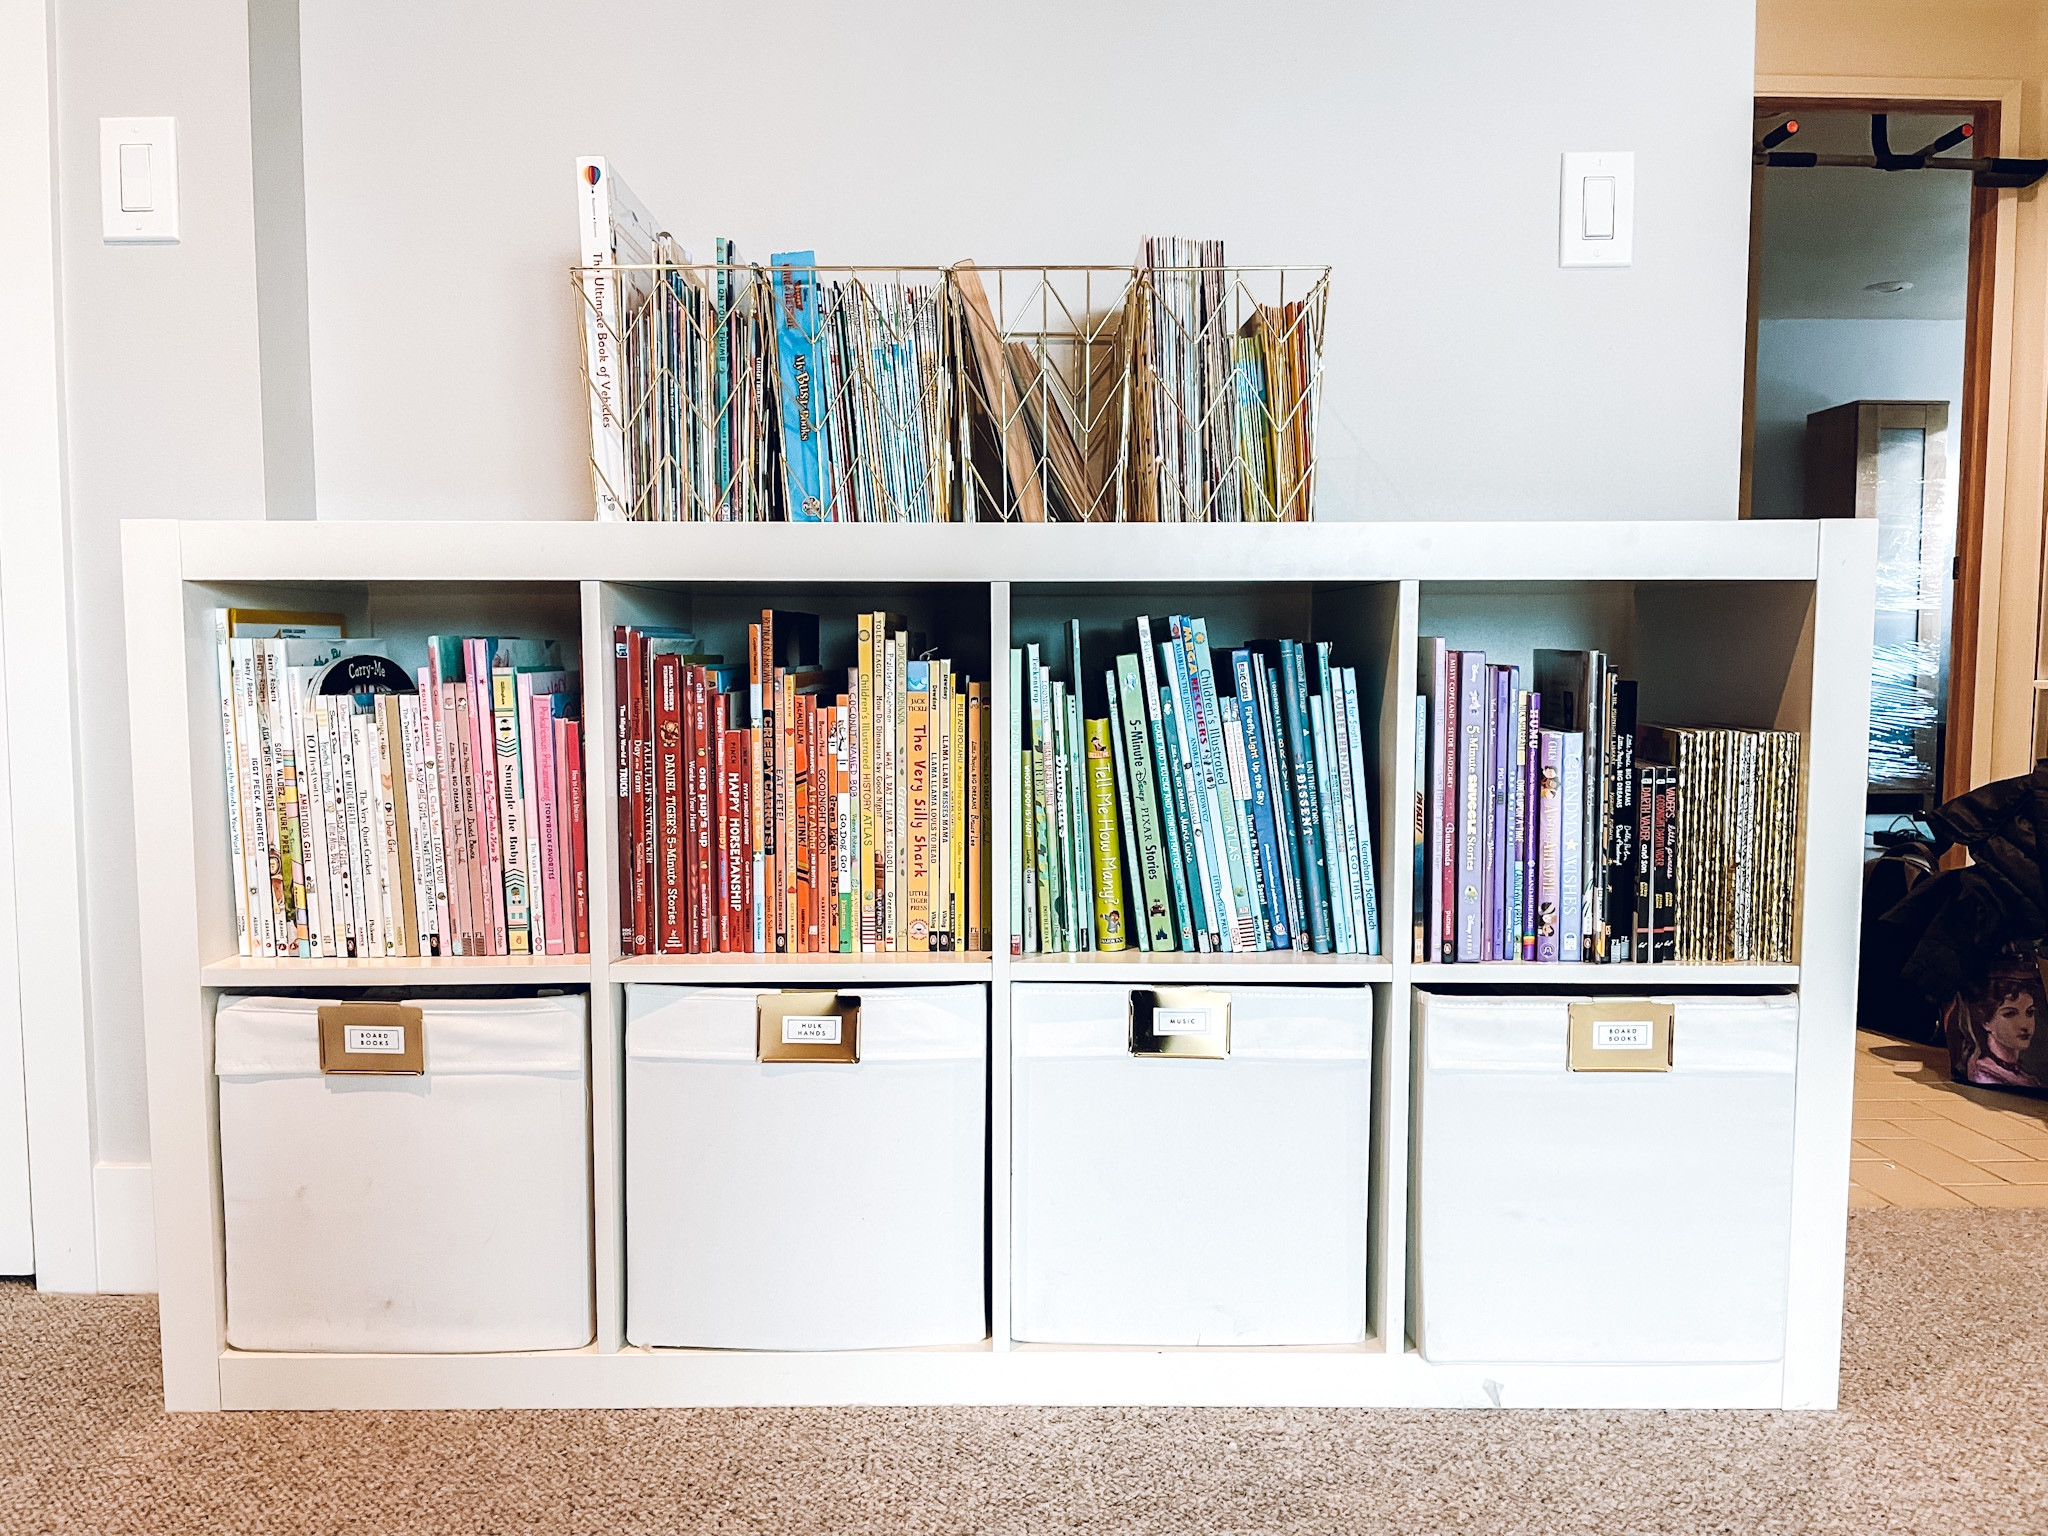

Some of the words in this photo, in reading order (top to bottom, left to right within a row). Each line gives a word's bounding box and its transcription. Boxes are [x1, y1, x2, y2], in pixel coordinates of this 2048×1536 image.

[718, 288, 725, 301] ON
[597, 332, 608, 362] Book
[597, 367, 609, 378] of
[794, 355, 805, 370] My
[796, 372, 811, 409] Busy
[600, 381, 611, 428] Vehicles
[348, 659, 386, 678] Carry-Me
[849, 681, 856, 689] A
[860, 673, 870, 720] Children's
[1183, 626, 1199, 676] MEGA
[1191, 676, 1208, 745] RESCUERS
[849, 692, 858, 739] COCONUT
[875, 695, 883, 711] How
[1334, 688, 1346, 729] LAURIE
[618, 717, 627, 738] Mighty
[876, 713, 883, 724] Do
[1529, 708, 1539, 750] HUMU
[763, 716, 774, 776] CREEPY
[861, 722, 870, 770] Illustrated
[913, 724, 927, 752] The
[1129, 719, 1144, 767] 5-Minute
[1154, 723, 1162, 745] CARS
[633, 739, 642, 757] Day
[850, 743, 858, 776] NAMED
[1466, 724, 1481, 774] 5-Minute
[621, 758, 627, 766] of
[644, 740, 653, 803] TALLULAH'S
[665, 753, 676, 793] DANIEL
[688, 760, 696, 782] Words
[875, 761, 883, 774] Say
[1095, 762, 1112, 788] Tell
[1200, 669, 1216, 725] Children's
[1209, 728, 1228, 785] Illustrated
[1223, 824, 1239, 862] ATLAS
[1295, 762, 1305, 771] I
[1306, 760, 1315, 774] UNI
[1337, 732, 1352, 800] HERNANDEZ
[504, 764, 515, 810] Snuggle
[619, 768, 629, 798] TRUCKS
[634, 770, 642, 794] Farm
[699, 767, 708, 791] one
[776, 769, 784, 787] EAT
[850, 779, 858, 798] BOB
[910, 760, 927, 792] Very
[1024, 765, 1032, 789] WHOSE
[1034, 758, 1045, 797] TREE
[1158, 761, 1170, 791] TRUCKS
[1307, 775, 1317, 794] THE
[360, 790, 368, 809] The
[689, 797, 697, 811] Your
[729, 772, 740, 812] HAPPY
[819, 768, 827, 824] GOODNIGHT
[863, 773, 871, 812] HISTORY
[930, 780, 938, 807] LLAMA
[941, 790, 949, 818] MISSES
[1024, 789, 1032, 810] POOP
[1099, 796, 1114, 814] Me
[1163, 792, 1171, 808] AND
[1296, 773, 1313, 836] DISSENT
[1466, 773, 1479, 835] SNUGGLE
[1563, 753, 1580, 839] GRANDMA
[1640, 787, 1651, 813] DARTH
[300, 793, 311, 839] AMBITIOUS
[361, 808, 370, 825] Very
[666, 795, 676, 835] TIGER'S
[696, 794, 709, 829] pup's
[764, 779, 774, 851] CARROTS!
[776, 793, 785, 821] PETE!
[875, 797, 883, 818] Night?
[910, 798, 928, 829] Silly
[930, 808, 938, 831] LOVES
[1024, 810, 1032, 818] IS
[1310, 794, 1319, 825] UNICORN
[1655, 794, 1665, 828] GOODNIGHT
[386, 820, 394, 838] Dear
[508, 814, 516, 832] the
[545, 802, 553, 843] STORYBOOK
[645, 805, 653, 864] NUTCRACKER
[690, 811, 698, 833] Heart
[718, 815, 728, 851] Dumpy
[863, 814, 872, 847] ATLAS
[941, 819, 949, 843] MAMA
[1025, 819, 1033, 838] THAT?
[1098, 820, 1114, 851] How
[1140, 807, 1152, 842] PIXAR
[1165, 810, 1174, 837] THINGS
[1246, 813, 1256, 837] There's
[1640, 815, 1650, 841] VADER
[362, 827, 371, 847] Quiet
[388, 839, 397, 854] Girl
[508, 836, 519, 865] Baby
[698, 831, 708, 847] up
[819, 826, 827, 855] MOON
[930, 833, 937, 843] TO
[1169, 838, 1178, 856] THAT
[1250, 838, 1257, 848] No
[1347, 824, 1357, 851] SHE'S
[1444, 822, 1455, 867] Bunheads
[1641, 843, 1649, 858] and
[1655, 828, 1665, 847] DARTH
[303, 841, 312, 864] GIRL
[365, 848, 373, 876] Cricket
[547, 844, 555, 880] FAVORITES
[667, 837, 678, 886] 5-Minute
[730, 817, 742, 912] HORSEMANSHIP
[913, 835, 928, 878] Shark
[930, 844, 938, 864] READ
[1145, 844, 1159, 880] Stories
[1172, 857, 1180, 869] GO
[1251, 849, 1261, 867] Place
[1350, 854, 1359, 875] GOT
[1466, 835, 1477, 871] Stories
[1655, 847, 1664, 867] VADER
[1255, 868, 1264, 883] Like
[1641, 860, 1650, 874] Son
[1101, 856, 1120, 906] Many?
[1258, 883, 1267, 905] Space!
[1353, 879, 1362, 901] THIS
[1563, 853, 1578, 916] WISHES
[667, 888, 678, 925] Stories
[1444, 909, 1453, 936] putnam
